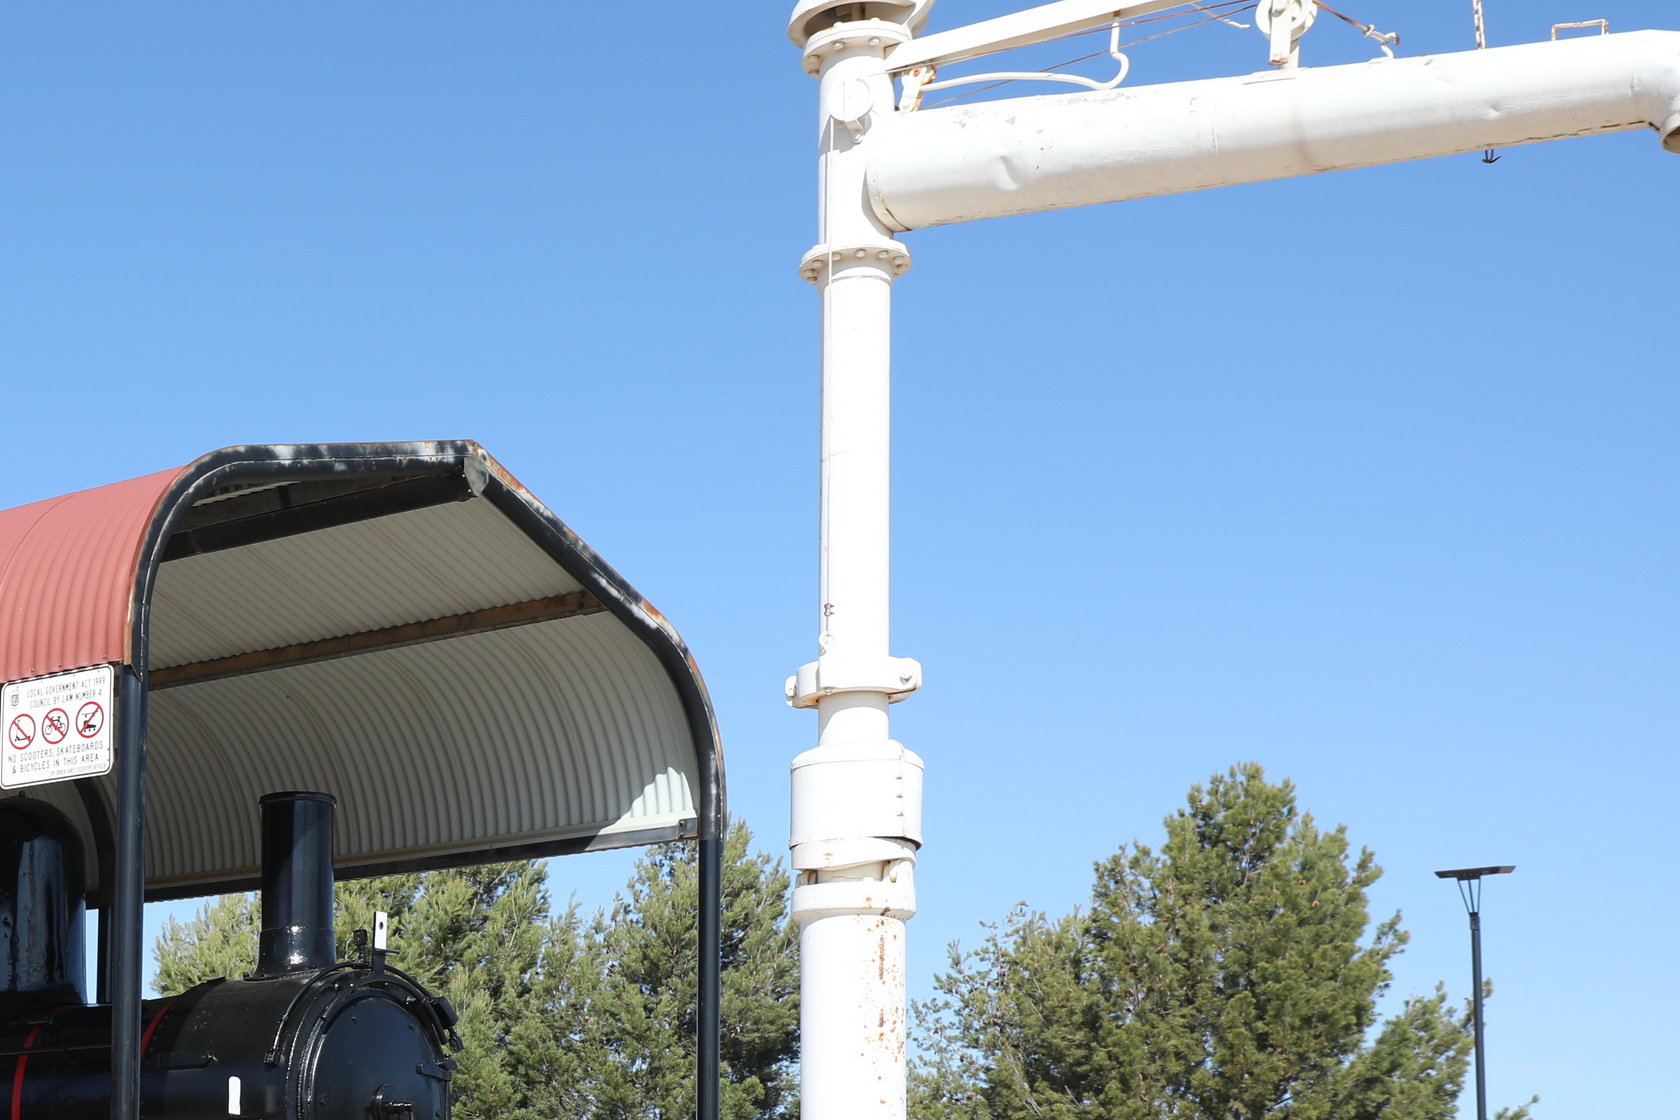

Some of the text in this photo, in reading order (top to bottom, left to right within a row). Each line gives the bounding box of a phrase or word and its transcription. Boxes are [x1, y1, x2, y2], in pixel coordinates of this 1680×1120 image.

[27, 676, 106, 698] LOCAL GOVERNMENT ACT 1999
[29, 697, 51, 709] COUNCIL
[53, 695, 60, 705] BY
[62, 693, 73, 703] LAW
[75, 690, 96, 701] NUMBER
[98, 688, 102, 696] 4
[8, 740, 104, 763] NO SCOOTERS, SKATEBOARDS
[11, 753, 99, 774] & BICYCLES IN THIS AREA
